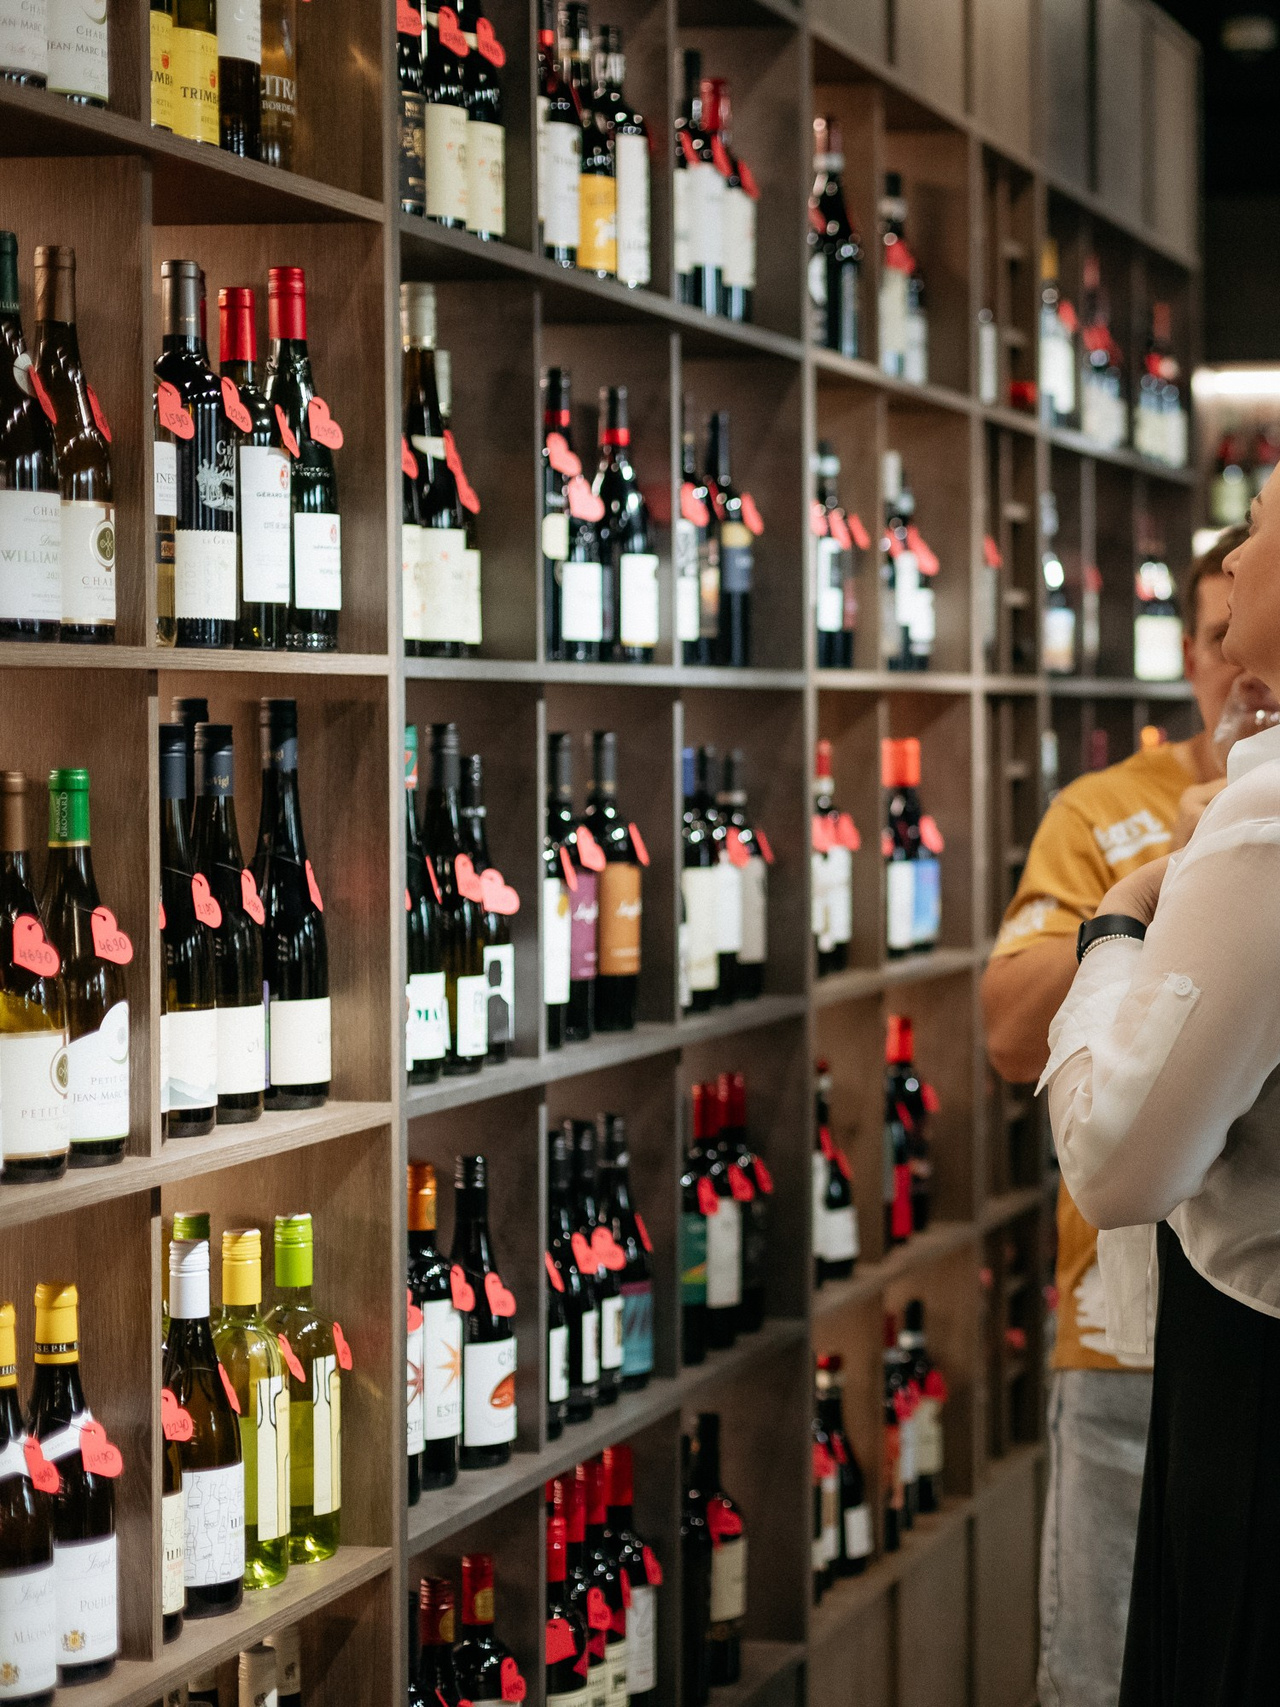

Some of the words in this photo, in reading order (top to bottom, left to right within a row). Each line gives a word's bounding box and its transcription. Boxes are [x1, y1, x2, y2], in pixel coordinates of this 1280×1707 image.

[60, 791, 68, 838] BROCARD
[98, 936, 126, 954] 4690
[166, 1419, 189, 1437] 2240
